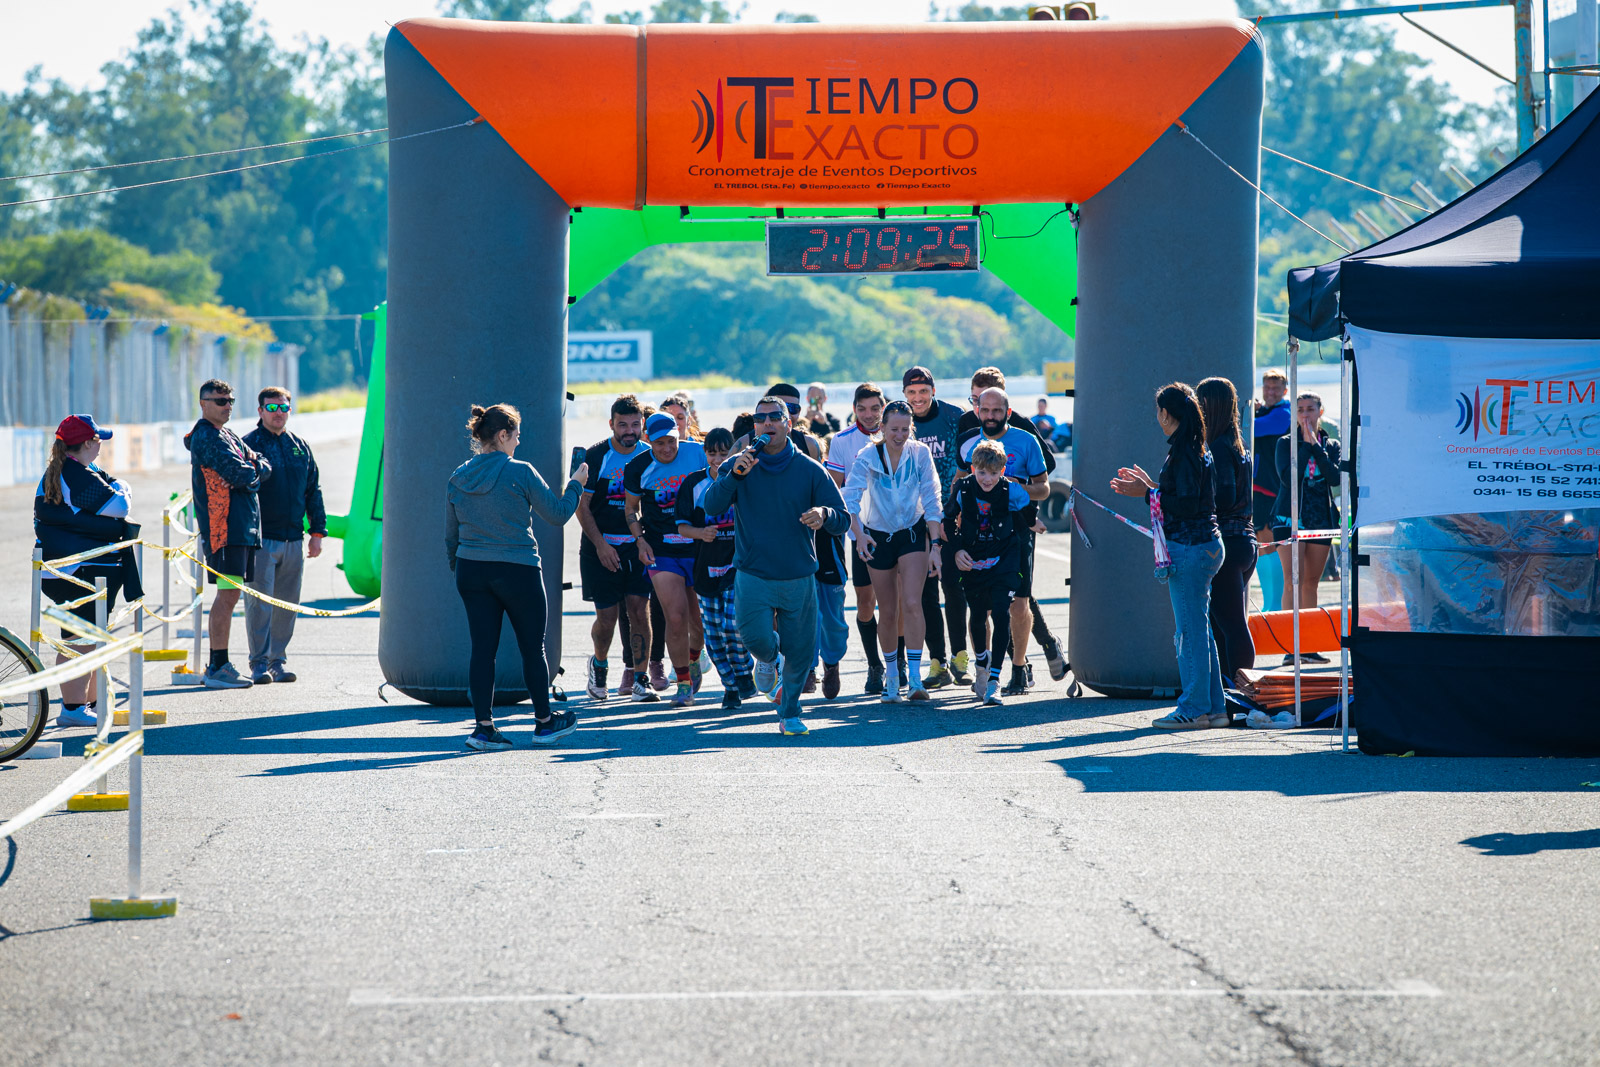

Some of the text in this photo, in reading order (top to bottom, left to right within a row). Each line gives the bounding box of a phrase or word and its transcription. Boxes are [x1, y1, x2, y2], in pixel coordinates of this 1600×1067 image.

[727, 77, 979, 159] TIEMPO
[768, 89, 979, 160] EXACTO
[688, 164, 977, 178] Cronometraje de Eventos Deportivos
[802, 225, 970, 270] 2:09:25
[1446, 444, 1518, 456] Cronometraje
[1522, 446, 1536, 455] de
[1539, 447, 1582, 456] Eventos
[1468, 460, 1600, 472] EL TRÉBOL-STA-
[1530, 476, 1546, 484] 15
[1551, 476, 1570, 484] 52
[1574, 477, 1600, 485] 741
[1474, 488, 1512, 496] 0341-
[1516, 488, 1532, 496] 15
[1537, 489, 1557, 497] 68
